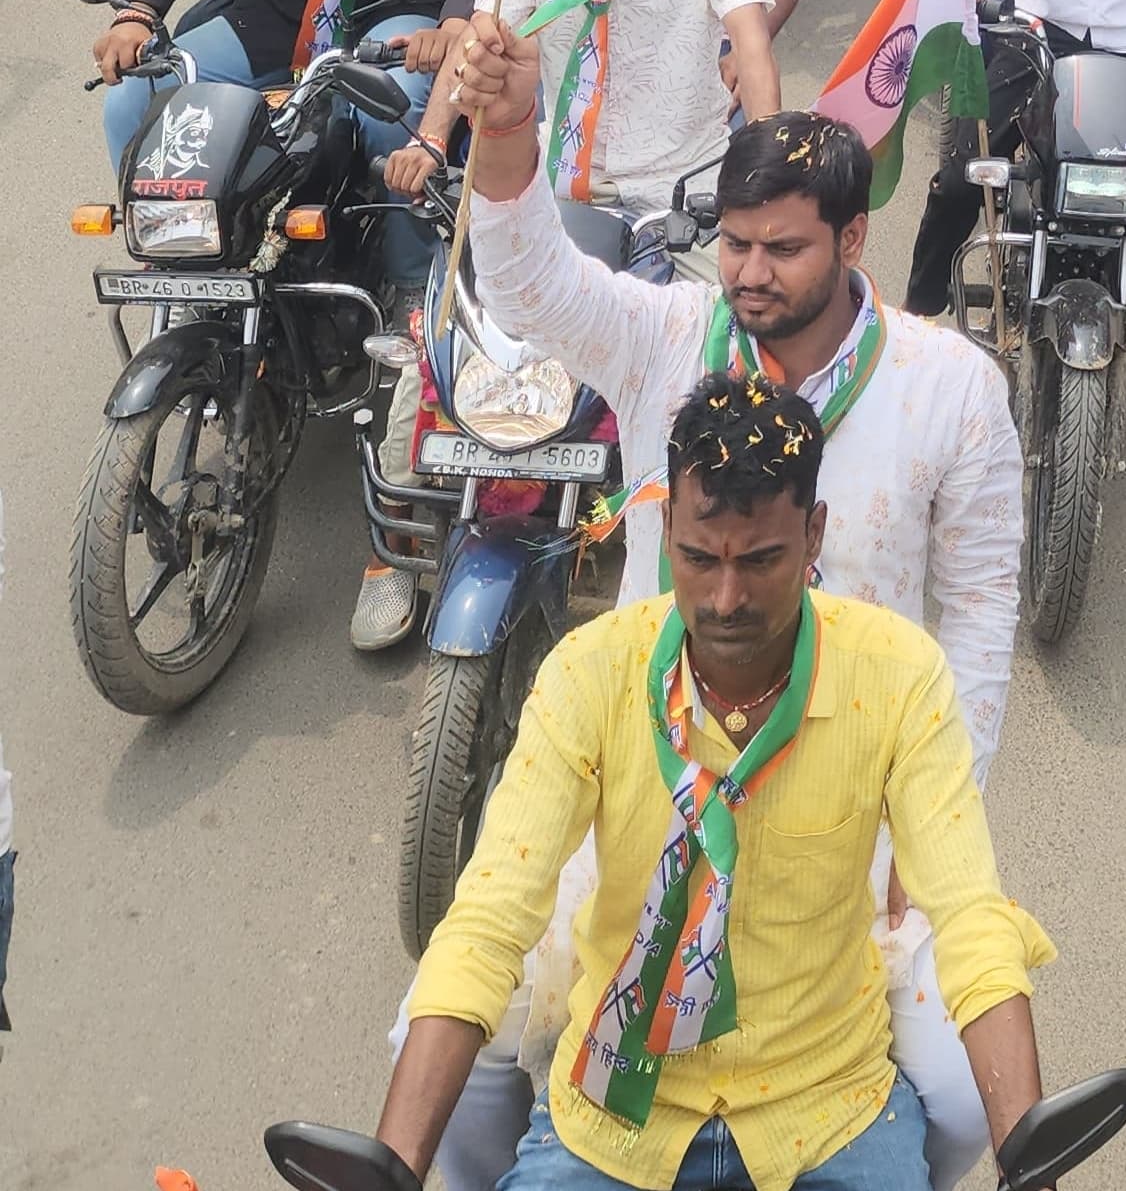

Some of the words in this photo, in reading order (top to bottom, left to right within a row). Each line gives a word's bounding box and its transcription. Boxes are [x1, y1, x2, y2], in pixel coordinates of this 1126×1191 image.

[120, 277, 143, 293] BR
[152, 279, 172, 294] 46
[202, 282, 246, 298] 1523
[546, 446, 600, 469] 5603
[633, 930, 662, 958] DIA
